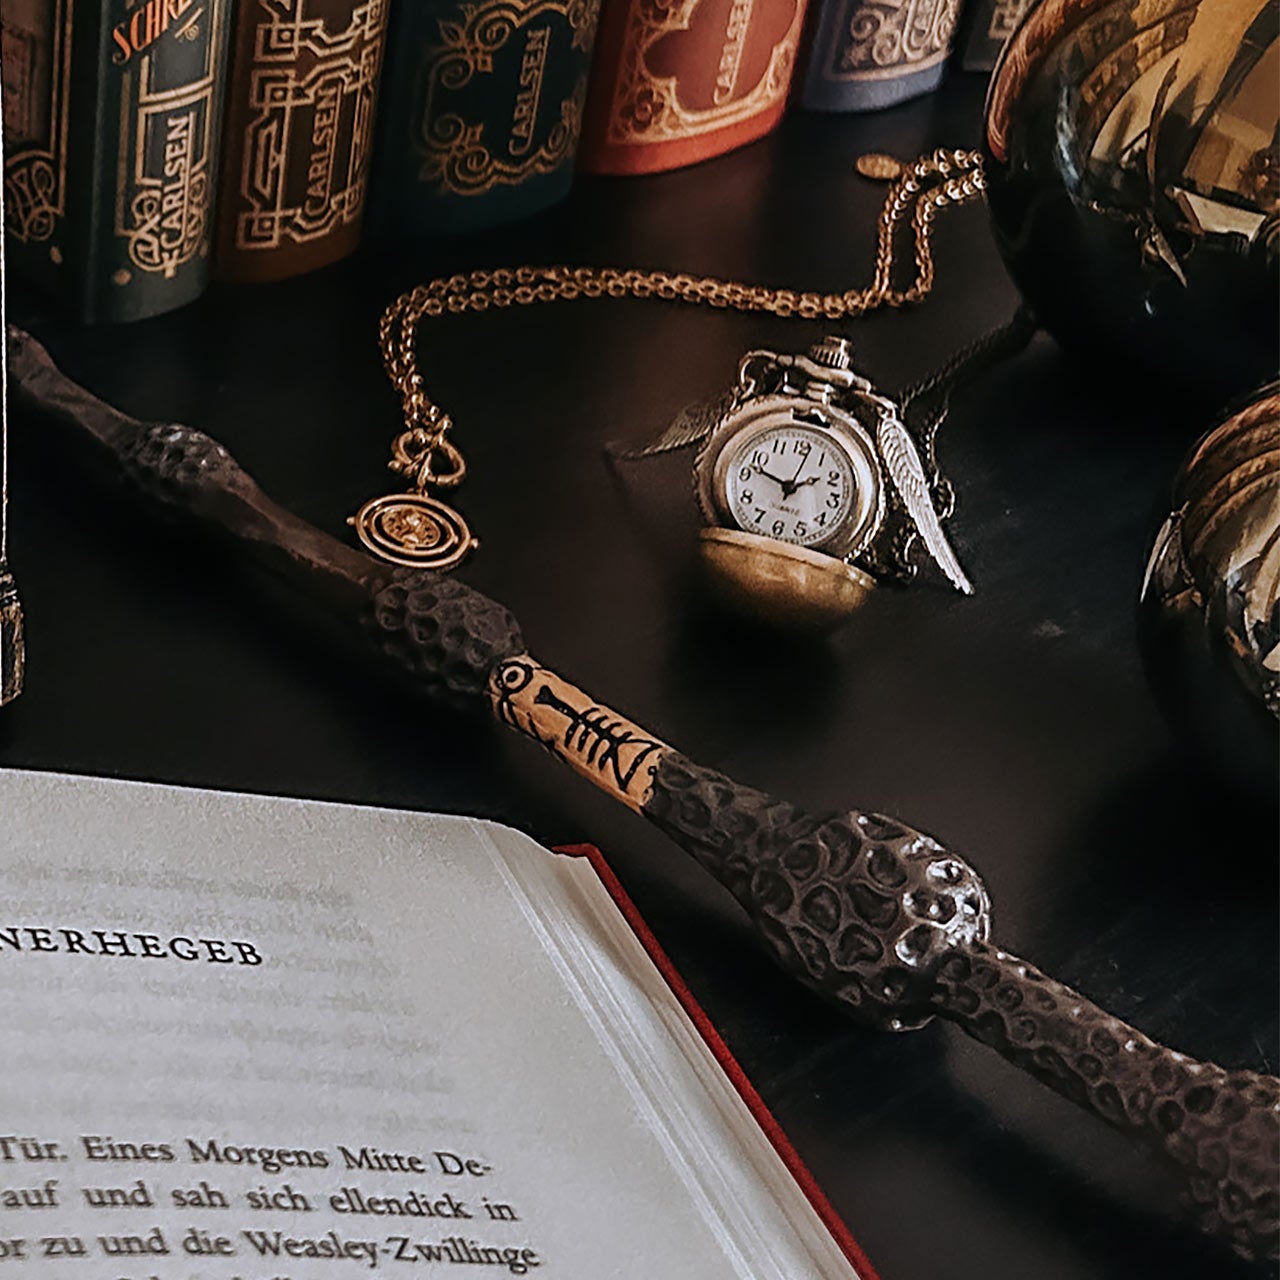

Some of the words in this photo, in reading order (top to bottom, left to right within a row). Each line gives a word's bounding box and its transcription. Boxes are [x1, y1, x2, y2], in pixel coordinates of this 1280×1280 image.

[160, 111, 197, 249] CARLSEN
[772, 439, 787, 455] 11
[793, 440, 811, 457] 12
[751, 450, 769, 467] 10
[818, 452, 826, 468] 1
[739, 467, 752, 482] 9
[826, 471, 840, 488] 2
[740, 489, 753, 505] 8
[826, 492, 840, 509] 3
[753, 507, 766, 524] 7
[813, 511, 827, 527] 4
[772, 520, 786, 536] 6
[793, 521, 808, 537] 5
[80, 1135, 176, 1164] Eines
[185, 1137, 329, 1174] Morgens
[337, 1144, 426, 1175] Mitte
[433, 1150, 492, 1180] De-
[2, 1180, 60, 1208] auf
[81, 1181, 155, 1209] und
[172, 1181, 230, 1210] sah
[246, 1183, 308, 1213] sich
[328, 1186, 472, 1220] ellendick
[483, 1196, 520, 1223] in
[42, 1234, 88, 1259] zu
[101, 1228, 170, 1257] und
[182, 1227, 235, 1257] die
[240, 1229, 543, 1276] Weasley-Zwillinge
